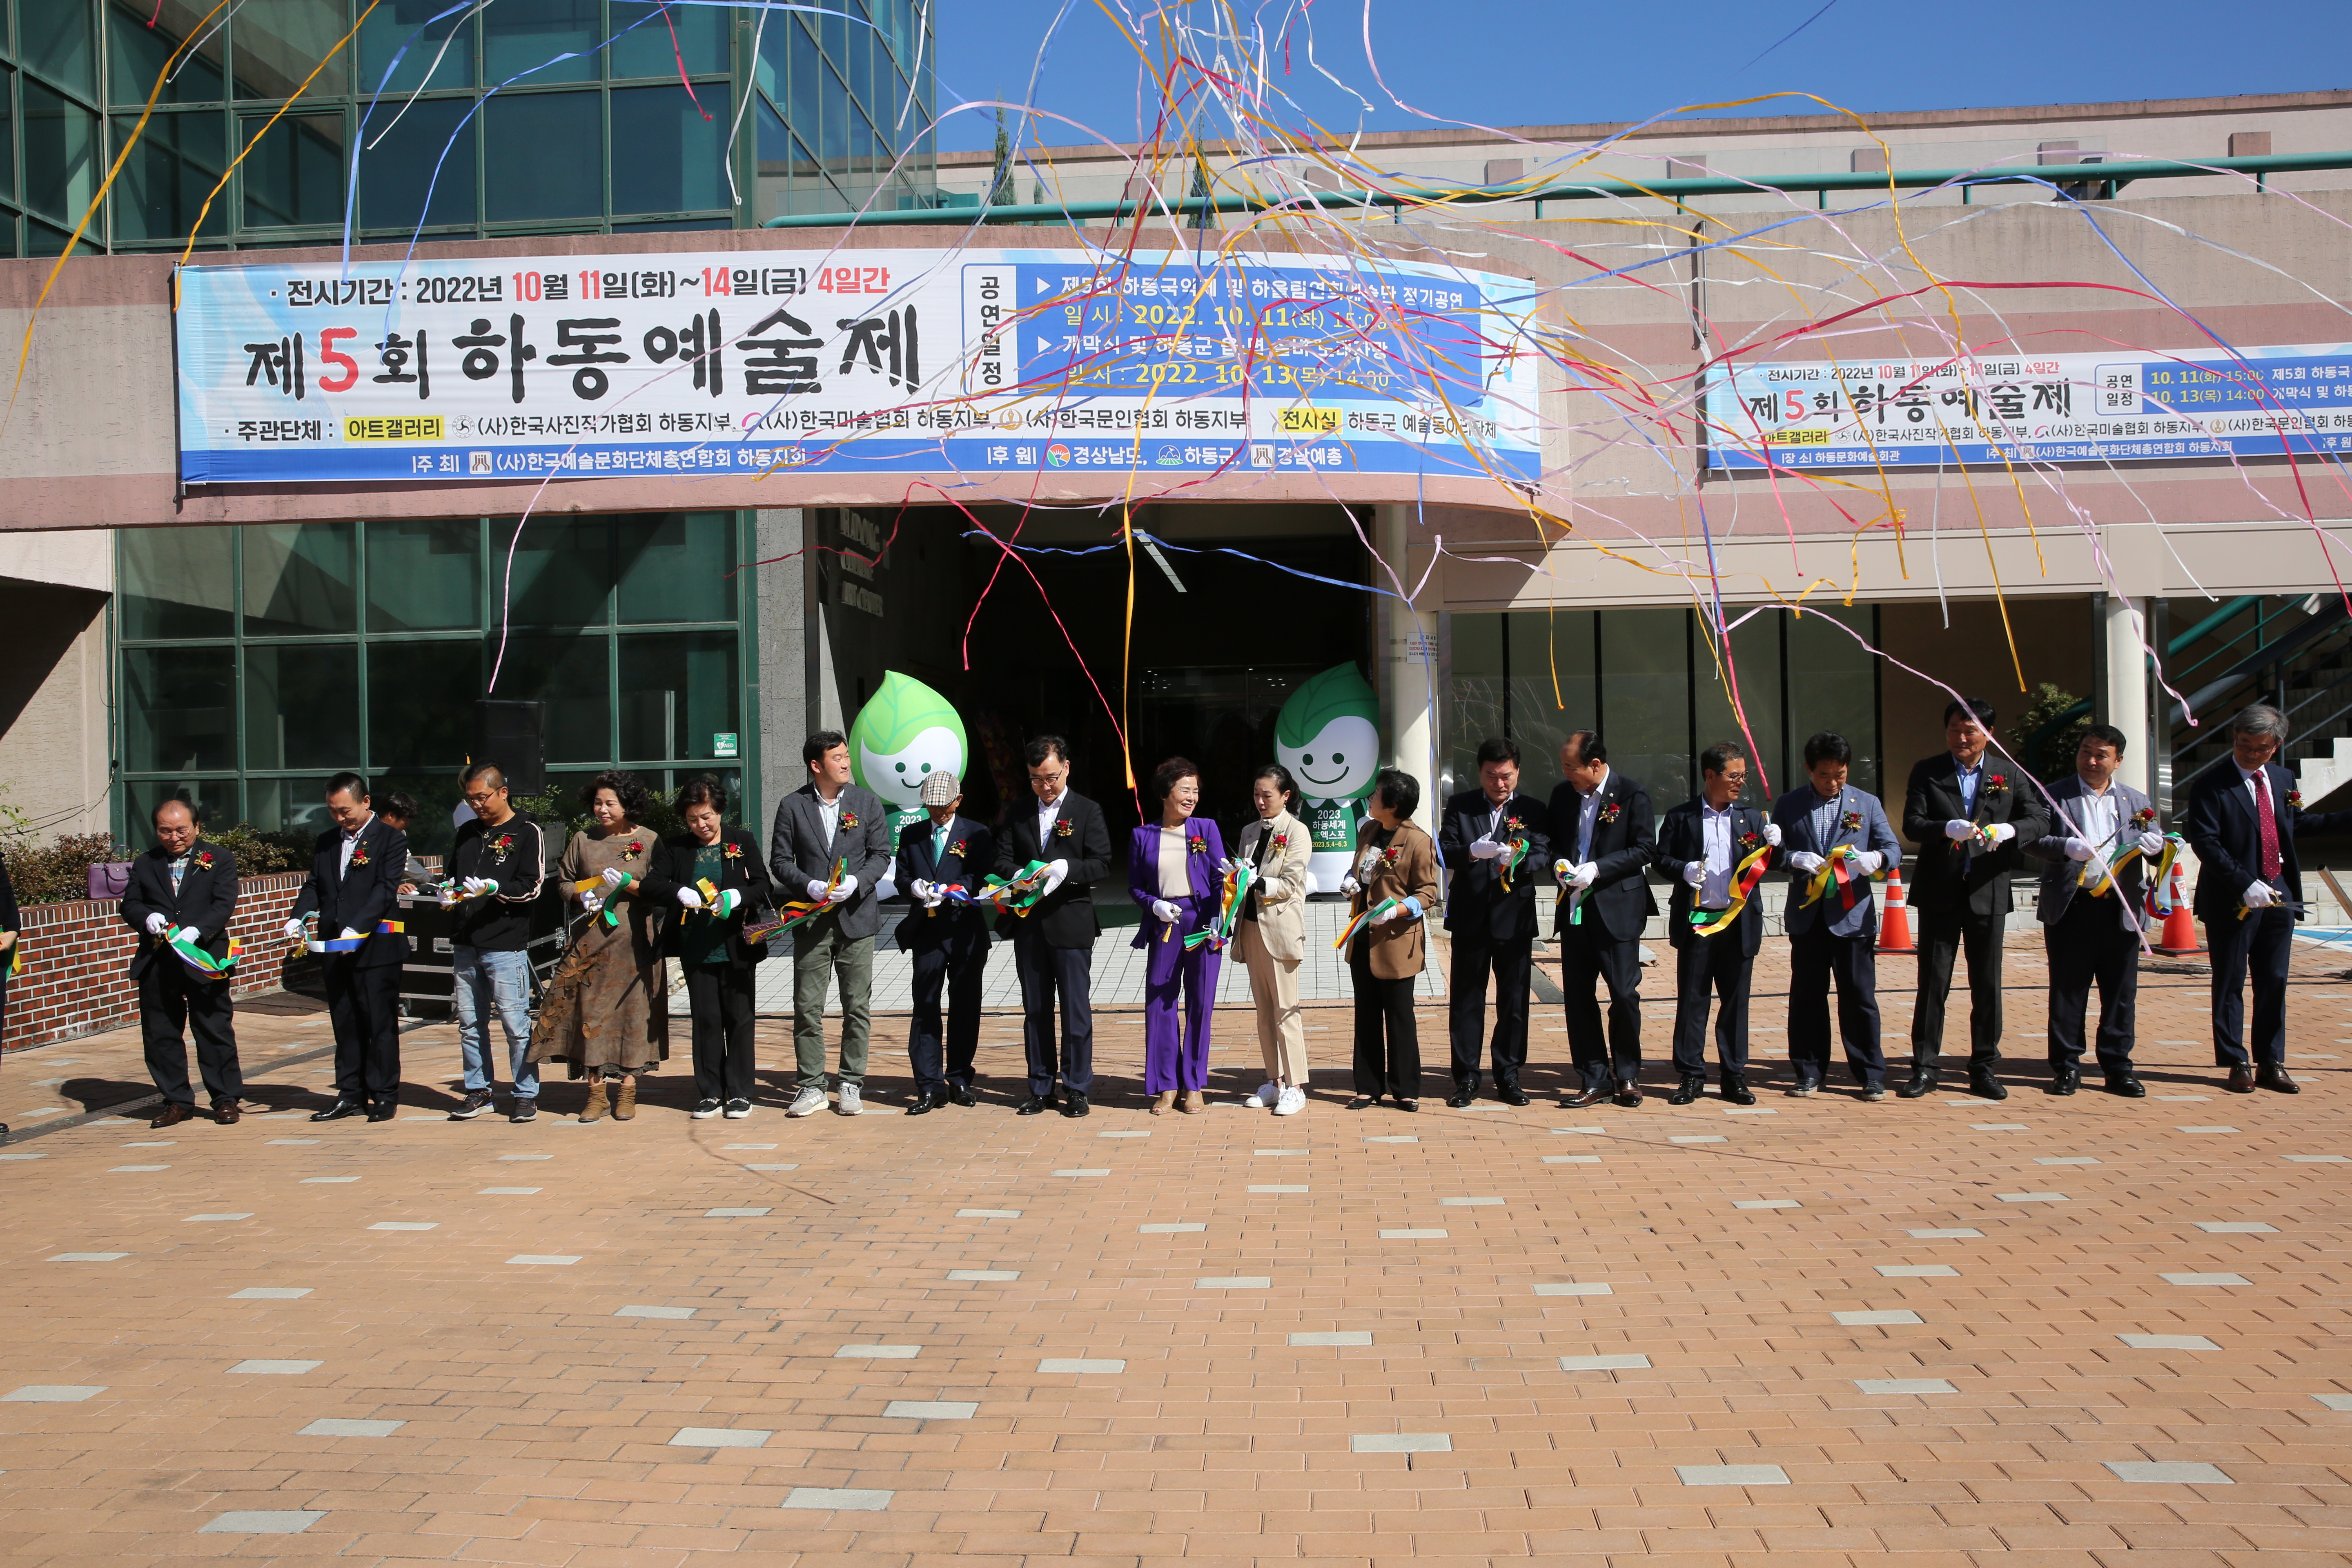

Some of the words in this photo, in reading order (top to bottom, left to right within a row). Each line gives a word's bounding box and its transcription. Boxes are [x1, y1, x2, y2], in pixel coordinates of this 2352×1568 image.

[288, 279, 393, 306] 전시기간
[416, 276, 503, 303] 2022년
[513, 271, 568, 301] 10월
[579, 267, 806, 300] 11일(화)~14일(금)
[818, 267, 890, 294] 4일간
[1062, 276, 1112, 296] 제5회
[1123, 276, 1217, 297] 하동국악제
[1226, 278, 1243, 298] 및
[1403, 287, 1463, 309] 정기공연
[1134, 305, 1203, 325] 2022.
[1214, 306, 1250, 326] 10.
[1262, 307, 1324, 329] 11(화)
[244, 327, 430, 401] 제5회
[452, 304, 920, 403] 하동예술제
[1062, 335, 1120, 354] 개막식
[1129, 336, 1146, 354] 및
[1156, 336, 1213, 356] 하동군
[1136, 363, 1205, 383] 2022.
[1262, 365, 1325, 387] 13(목)
[1768, 368, 1820, 382] 전시기간
[1831, 367, 1873, 380] 2022년
[1878, 366, 1906, 379] 10월
[2025, 361, 2060, 374] 4일간
[2151, 371, 2174, 385] 10.
[2180, 370, 2221, 384] 11(화)
[2226, 369, 2264, 382] 15:00
[2272, 366, 2306, 381] 제5회
[2311, 365, 2352, 379] 하동국
[1749, 390, 1839, 423] 제5회
[1850, 377, 2071, 424] 하동예술제
[2152, 390, 2174, 403] 10.
[2180, 389, 2222, 403] 13(목)
[2226, 388, 2265, 401] 14:00
[2272, 386, 2311, 400] 개막식
[2316, 385, 2328, 399] 및
[238, 421, 321, 441] 주관단체
[349, 418, 440, 438] 아트갤러리
[478, 412, 651, 436] (사)한국사진작가협회
[766, 410, 909, 430] (사)한국미술협회
[917, 410, 995, 430] 하동지부,
[1026, 409, 1167, 429] (사)한국문인협회
[1176, 410, 1247, 430] 하동지부
[1283, 410, 1336, 430] 전시실
[1348, 411, 1396, 431] 하동군
[2051, 421, 2149, 437] (사)한국미술협회
[2228, 415, 2328, 431] (사)한국문인협회
[1764, 430, 1827, 444] 아트갤러리
[1853, 427, 1973, 442] (사)한국사진작가협회
[497, 448, 731, 471] (사)한국예술문화단체총연합회
[737, 448, 806, 467] 하동지회
[1073, 446, 1147, 466] 경상남도,
[1184, 447, 1240, 465] 하동군,
[1277, 447, 1342, 466] 경남예총
[1815, 450, 1900, 463] 하동문화예술회관
[2036, 442, 2185, 458] (사)한국예술문화단체총연합회
[2189, 441, 2232, 453] 하동지회
[900, 815, 922, 824] 2023
[1317, 809, 1341, 819] 2023
[1312, 820, 1346, 830] 하동세계
[1312, 831, 1346, 840] 茶엑스포
